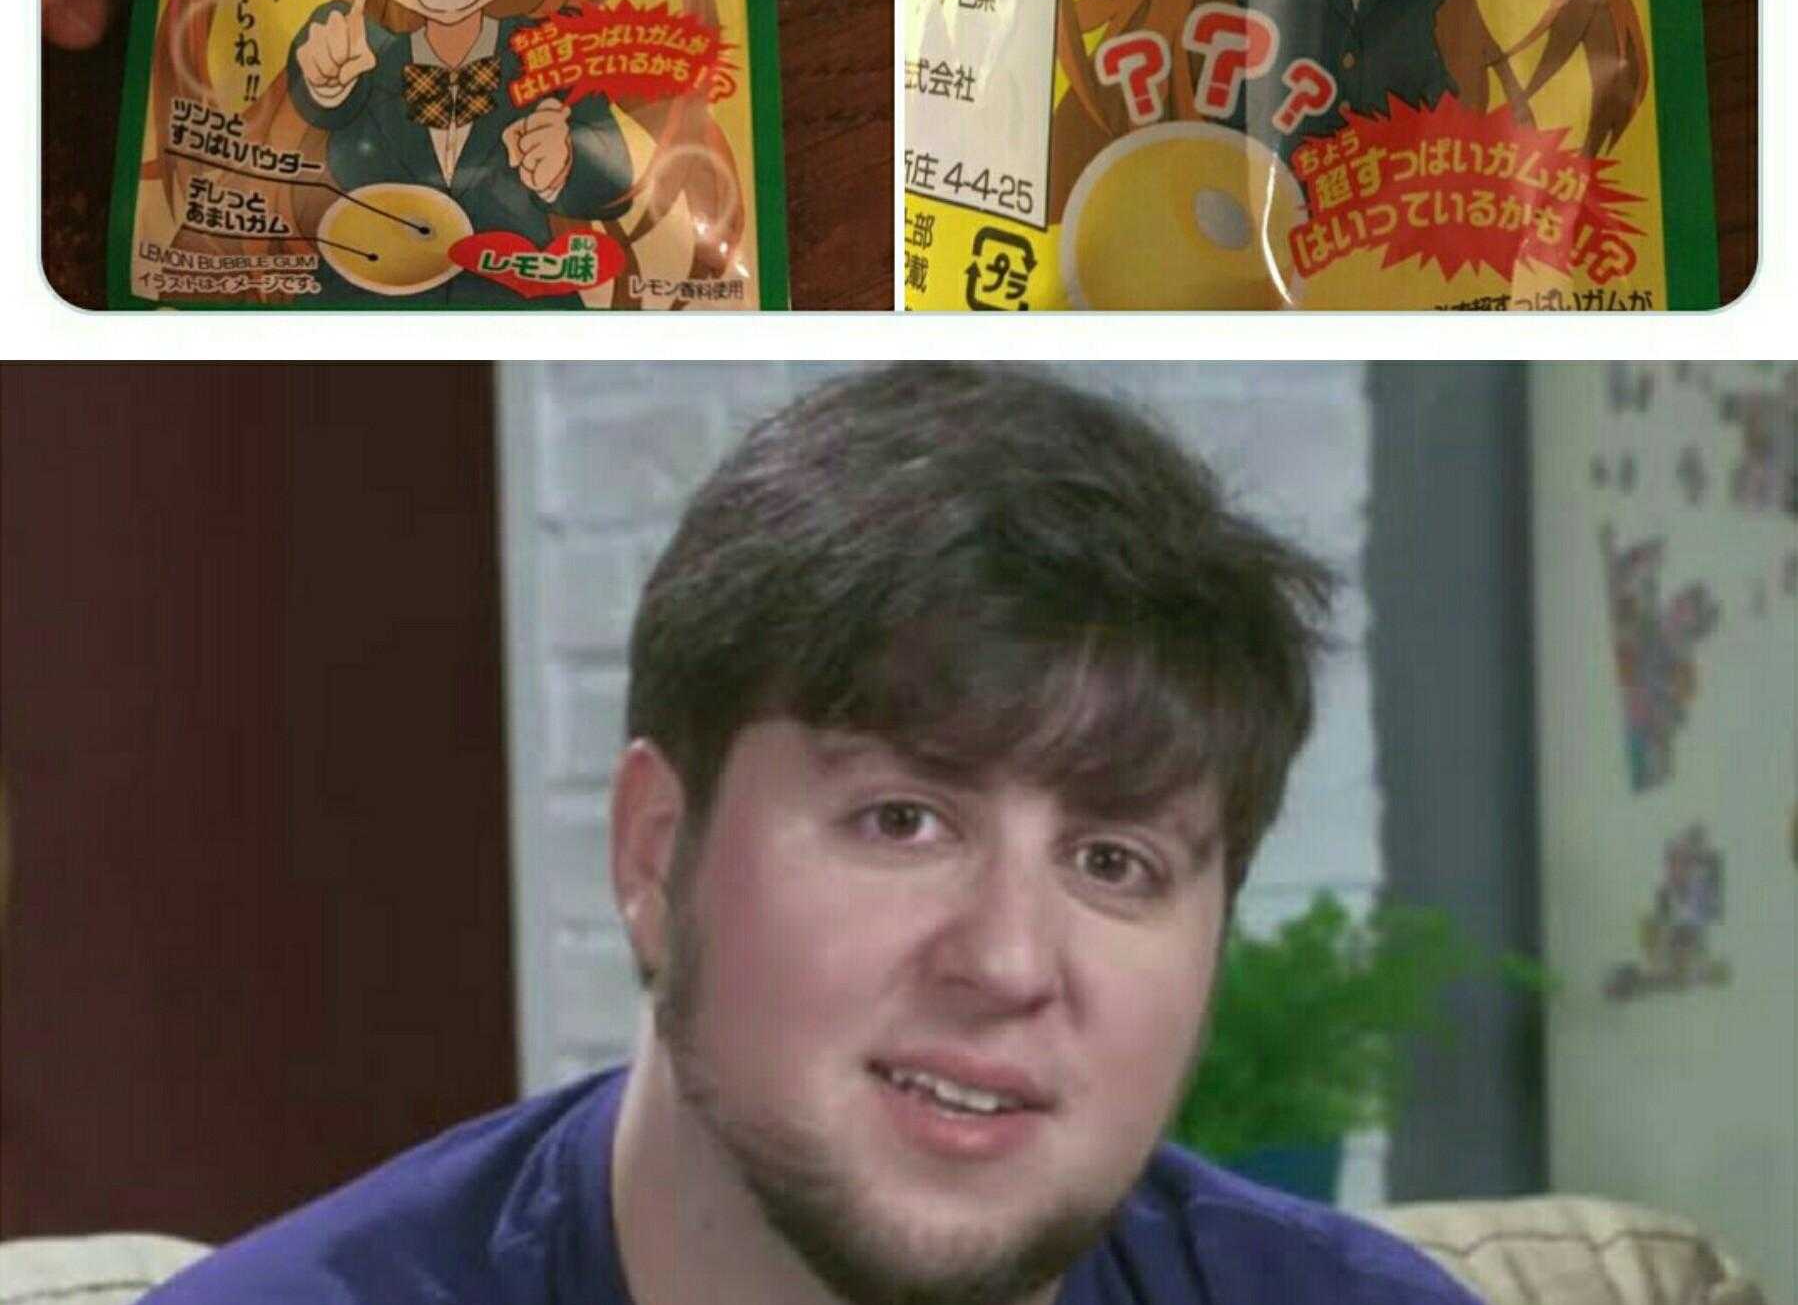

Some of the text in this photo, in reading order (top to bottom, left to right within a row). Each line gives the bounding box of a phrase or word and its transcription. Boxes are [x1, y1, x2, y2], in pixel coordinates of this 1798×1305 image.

[512, 20, 559, 51] ちょう
[1300, 130, 1361, 174] ちょう
[943, 161, 1034, 215] 4-4-25
[1313, 137, 1590, 210] 超すっぱいガムが
[189, 176, 267, 212] デレっと
[186, 200, 291, 236] あまいガム
[139, 243, 317, 271] LEMON BUBBLE GUM
[481, 250, 598, 283] レモン味
[138, 273, 322, 293] イラストはイメージです。
